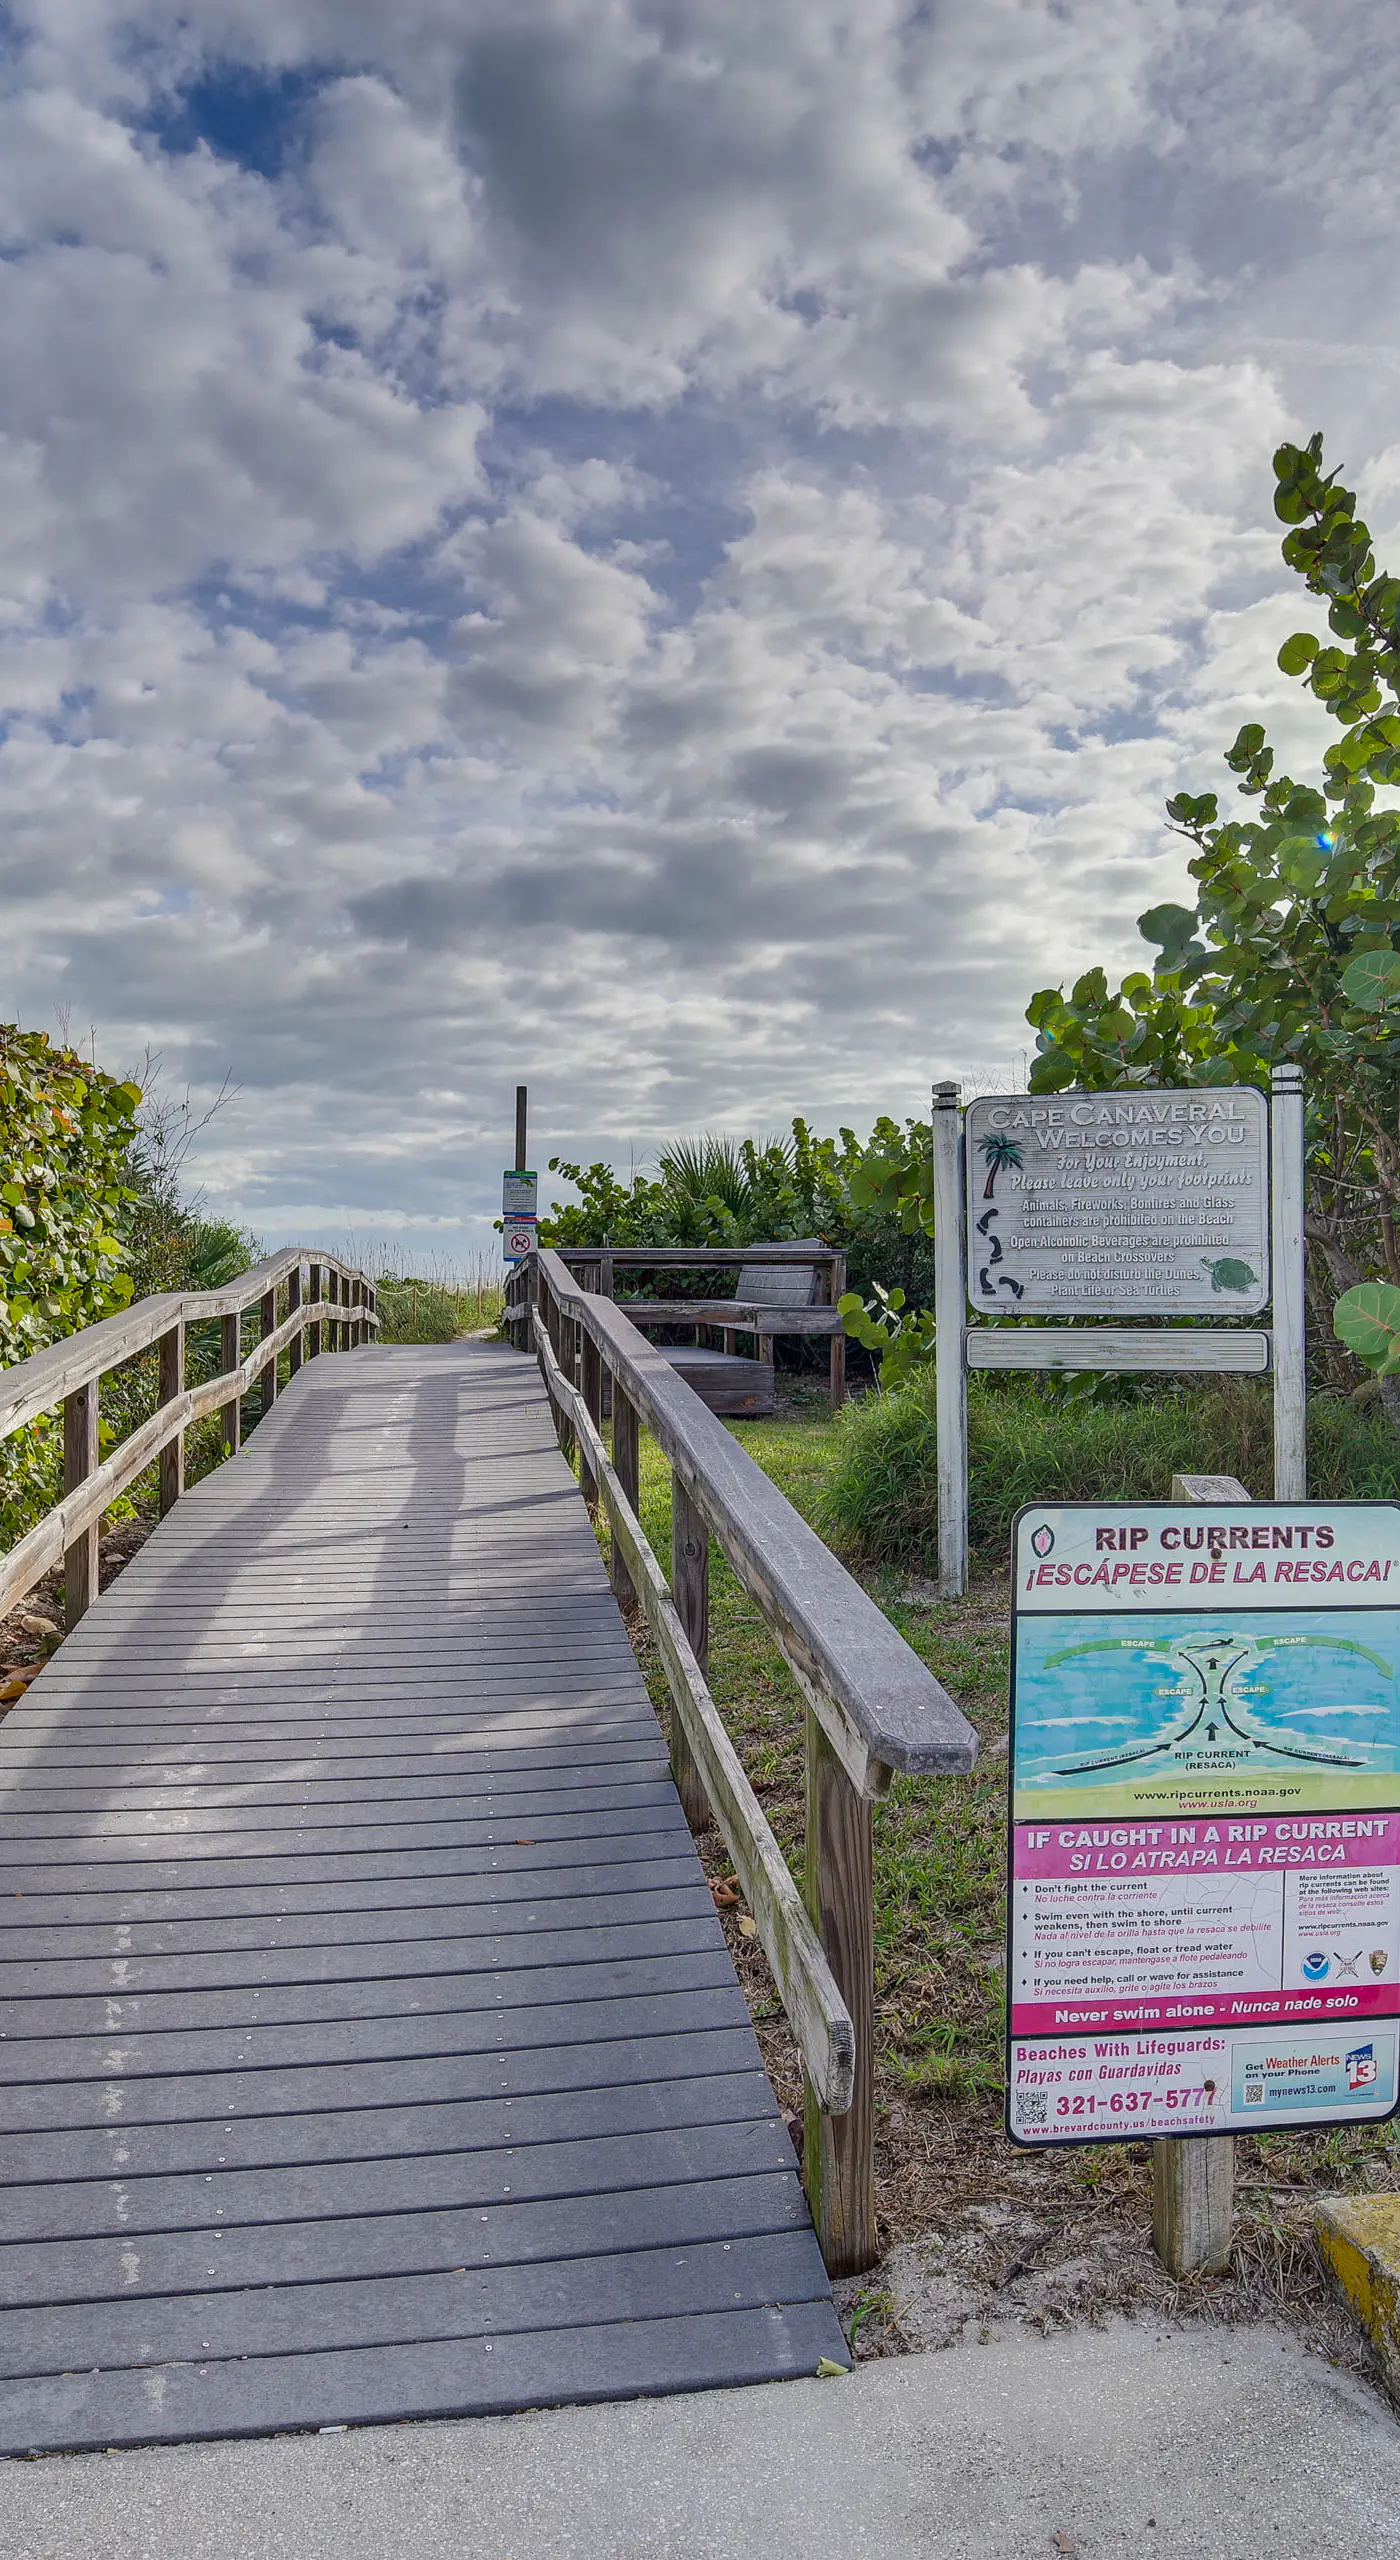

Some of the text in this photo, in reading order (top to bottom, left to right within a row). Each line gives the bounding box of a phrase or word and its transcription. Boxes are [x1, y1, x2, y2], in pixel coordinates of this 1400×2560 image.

[988, 1102, 1245, 1129] CAPE CANAVERAL
[1036, 1124, 1245, 1150] WELCOMES YOU
[1057, 1150, 1208, 1172] For Your Enjoyment,
[1011, 1172, 1252, 1192] Please leave only your footprints
[1022, 1197, 1234, 1212] Animals, Fireworks, Bonfires and Glass
[1024, 1212, 1233, 1228] containers are prohibited on the Beach
[1010, 1234, 1229, 1249] Open Alcoholic Beverages are prohibited
[1062, 1252, 1175, 1262] on Beach Crossovers
[1030, 1268, 1064, 1280] Please
[1068, 1268, 1080, 1280] do
[1084, 1270, 1101, 1280] not
[1104, 1268, 1140, 1280] disturb
[1145, 1268, 1162, 1279] the
[1052, 1284, 1180, 1296] Plant Life or Sea Turtles
[1096, 1526, 1335, 1550] RIP CURRENTS
[1026, 1558, 1183, 1591] ¡ESCÁPESE
[1189, 1562, 1226, 1584] DE
[1233, 1562, 1266, 1584] LA
[1174, 1750, 1250, 1760] RIP CURRENT
[1185, 1760, 1236, 1770] (RESACA)
[1134, 1788, 1301, 1801] www.ripcurrents.noaa.gov
[1178, 1799, 1258, 1809] www.usla.org
[1027, 1820, 1389, 1849] IF CAUGHT IN A RIP CURRENT
[1069, 1844, 1346, 1871] SI LO ATRAPA LA RESACA
[1035, 1885, 1061, 1893] Don't
[1065, 1884, 1088, 1893] fight
[1110, 1882, 1147, 1890] current
[1118, 1892, 1157, 1900] corriente
[1093, 1911, 1114, 1919] with
[1118, 1910, 1134, 1918] the
[1172, 1908, 1193, 1916] until
[1196, 1906, 1232, 1914] current
[1035, 1922, 1083, 1930] weakens,
[1086, 1921, 1108, 1929] then
[1298, 1921, 1388, 1930] www.ripcurrents.noaa.gov
[1045, 1951, 1063, 1960] you
[1095, 1949, 1133, 1957] escape,
[1176, 1944, 1201, 1952] tread
[1044, 1979, 1062, 1987] you
[1064, 1977, 1088, 1985] need
[1091, 1976, 1114, 1985] help,
[1117, 1974, 1134, 1983] call
[1193, 1970, 1244, 1978] assistance
[1055, 2009, 1108, 2023] Never
[1113, 2007, 1160, 2021] swim
[1166, 2004, 1214, 2018] alone
[1231, 2001, 1280, 2014] Nunca
[1285, 1998, 1322, 2010] nade
[1326, 1995, 1358, 2008] solo
[1016, 2037, 1226, 2061] Beaches With Lifeguards:
[1266, 2057, 1308, 2069] Weather
[1310, 2055, 1340, 2066] Alerts
[1017, 2062, 1181, 2085] Playas con Guardavidas
[1262, 2071, 1285, 2079] your
[1347, 2060, 1376, 2083] 13
[1269, 2085, 1336, 2098] mynews13.com
[1056, 2087, 1216, 2116] 321-637-5777
[1023, 2115, 1215, 2135] www.brevardcounty.us/beachsafety
